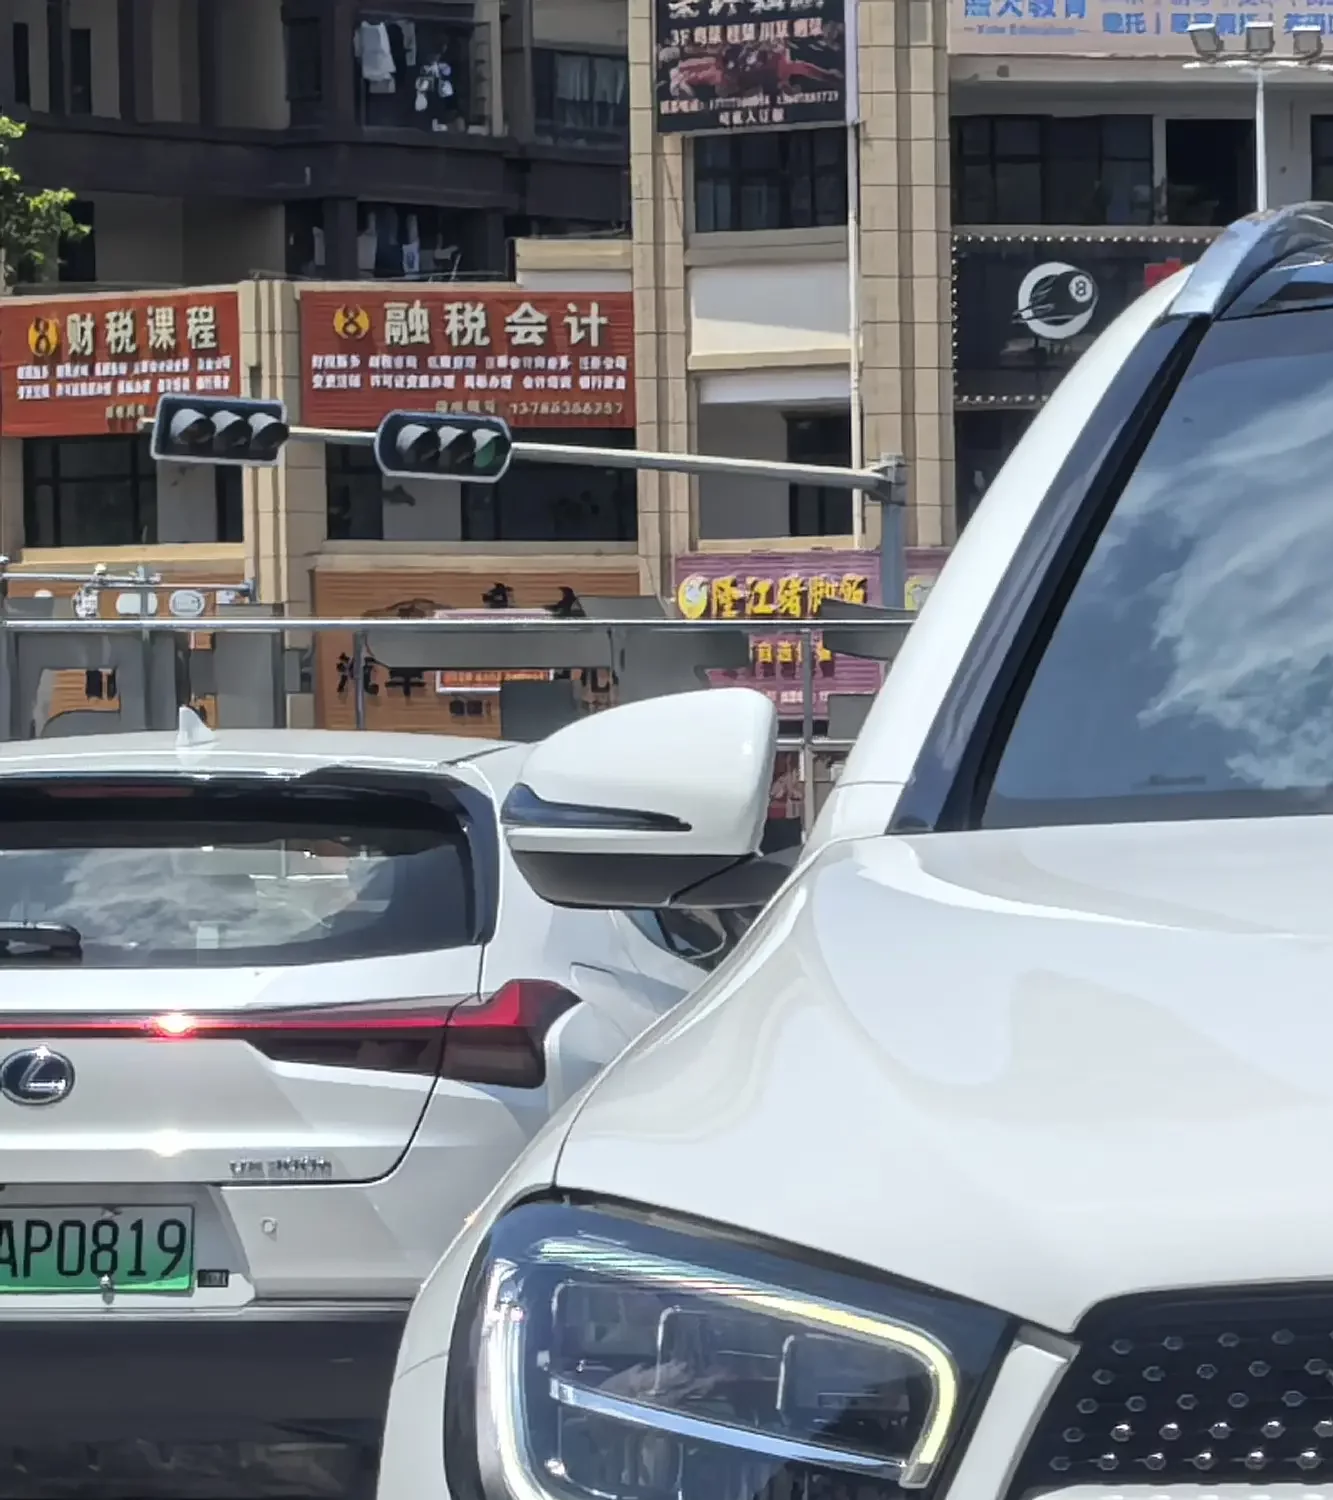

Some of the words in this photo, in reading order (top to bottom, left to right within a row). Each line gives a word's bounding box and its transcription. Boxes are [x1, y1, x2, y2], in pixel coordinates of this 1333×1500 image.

[66, 306, 217, 356] 财税课程
[384, 300, 609, 347] 融税会计
[0, 1219, 187, 1278] AP0819
